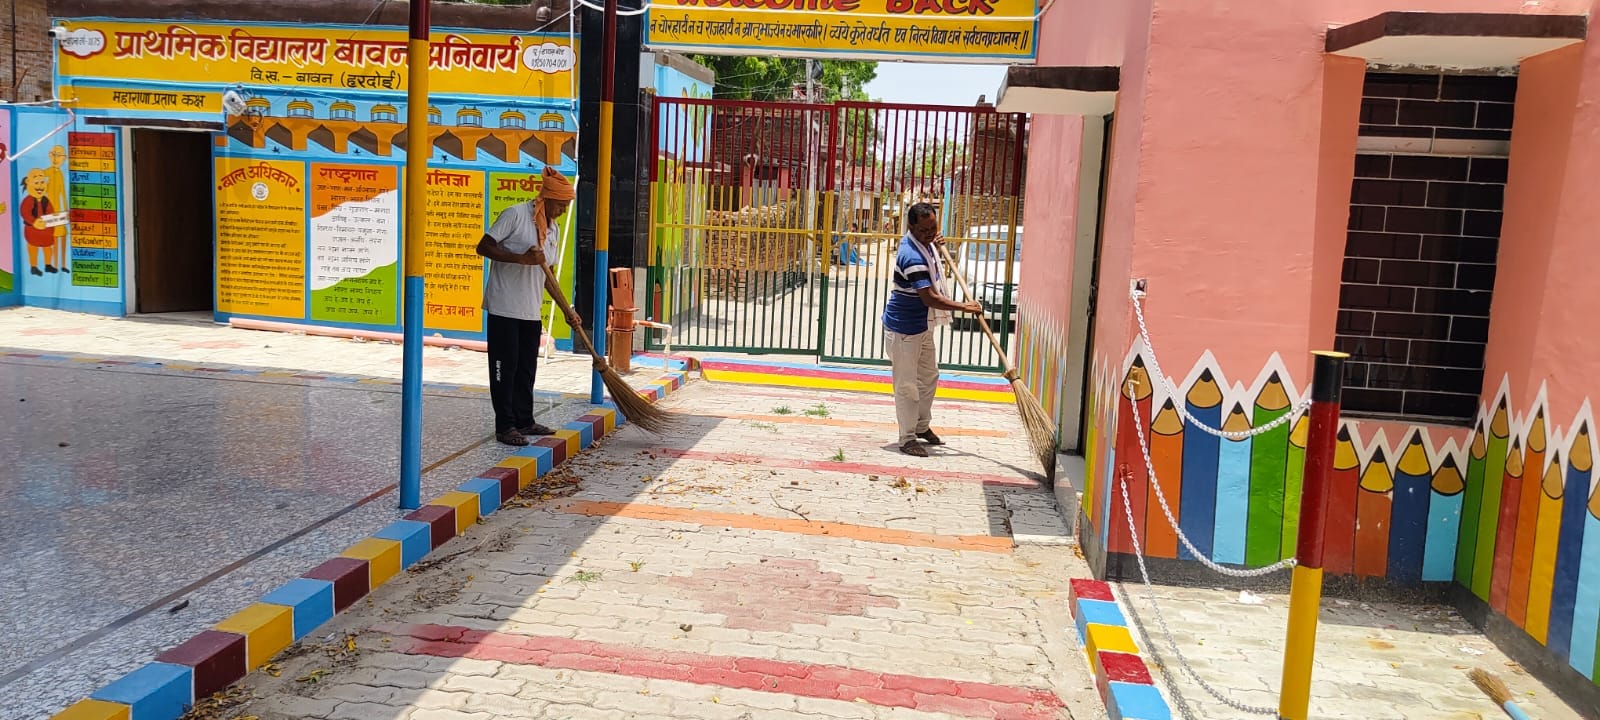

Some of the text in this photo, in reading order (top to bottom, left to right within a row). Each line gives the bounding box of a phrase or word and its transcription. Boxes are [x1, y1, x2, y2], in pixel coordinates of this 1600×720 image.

[895, 28, 908, 43] एव
[112, 25, 226, 60] प्राथमिक
[228, 29, 329, 68] विद्यालय
[295, 71, 335, 85] बावन
[340, 71, 402, 90] (हरदोई)
[112, 90, 206, 110] महाराणा प्रताप कक्ष
[220, 168, 248, 188] बाल
[247, 162, 298, 191] अधिकार
